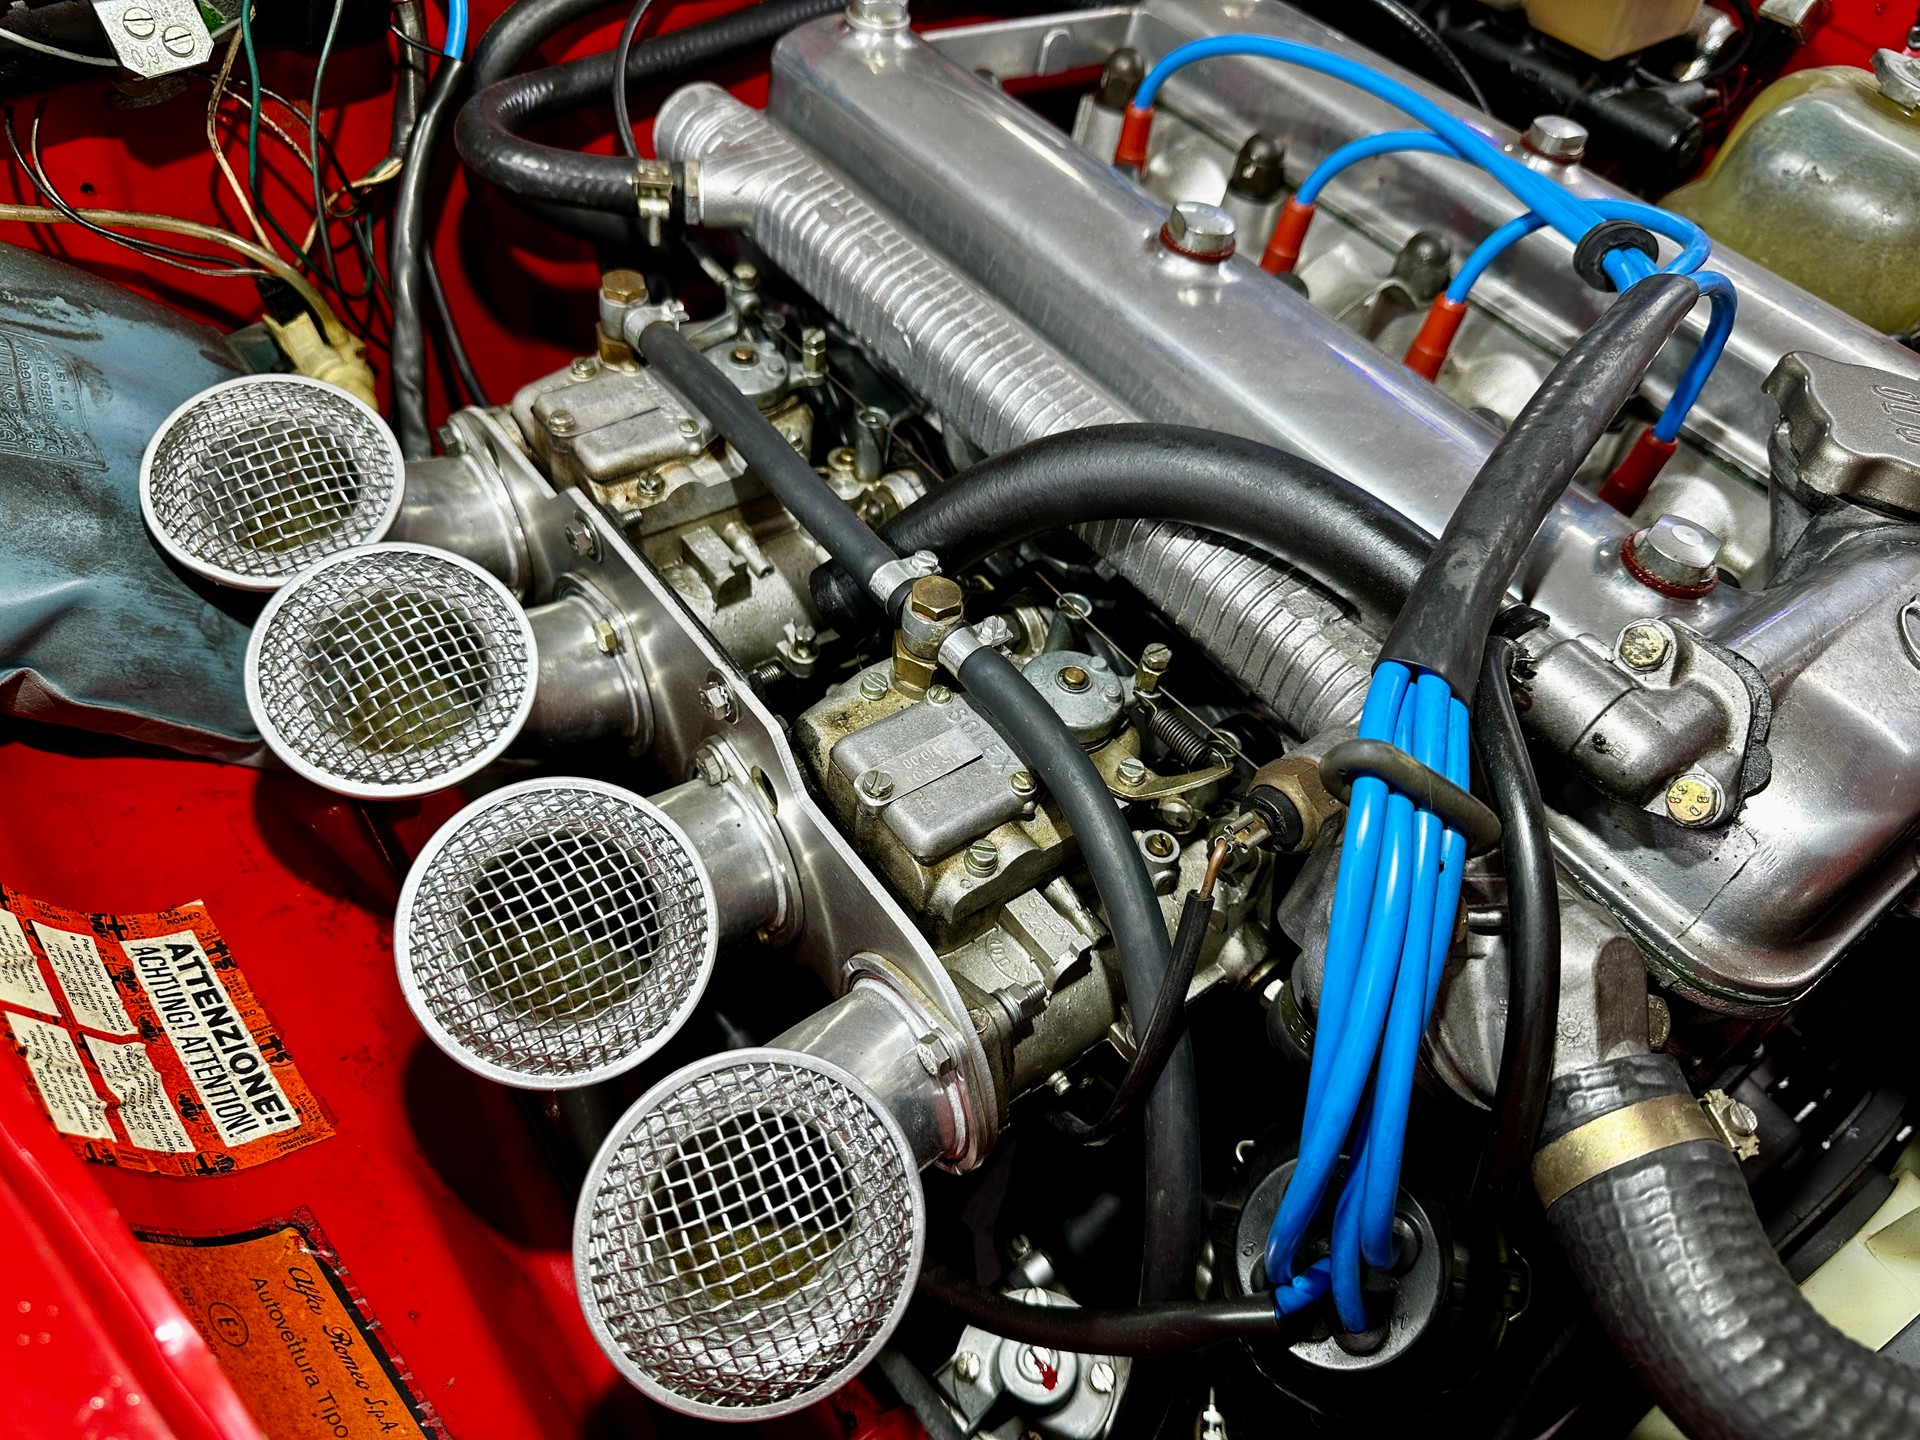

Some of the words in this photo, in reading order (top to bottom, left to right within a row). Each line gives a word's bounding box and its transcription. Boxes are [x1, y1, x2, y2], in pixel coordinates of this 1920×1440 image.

[166, 911, 201, 926] ROMEO
[1028, 896, 1070, 942] SOLEX
[54, 943, 72, 973] ricambi
[81, 939, 90, 951] Per
[31, 974, 44, 990] and
[45, 942, 60, 965] ALFA
[58, 971, 79, 1005] ROMEO
[28, 1031, 38, 1045] des
[131, 947, 190, 1030] ACHTUNG!
[177, 1036, 259, 1138] ATTENTION!
[166, 943, 291, 1125] ATTENZIONE!
[35, 1068, 60, 1107] ROMEO
[141, 1112, 164, 1147] original
[172, 1130, 187, 1148] und
[252, 1279, 320, 1388] Autovettura
[317, 1390, 348, 1439] Tipo
[285, 1267, 322, 1315] Alfa
[322, 1325, 370, 1390] Romeo
[363, 1397, 399, 1435] S.p.A.
